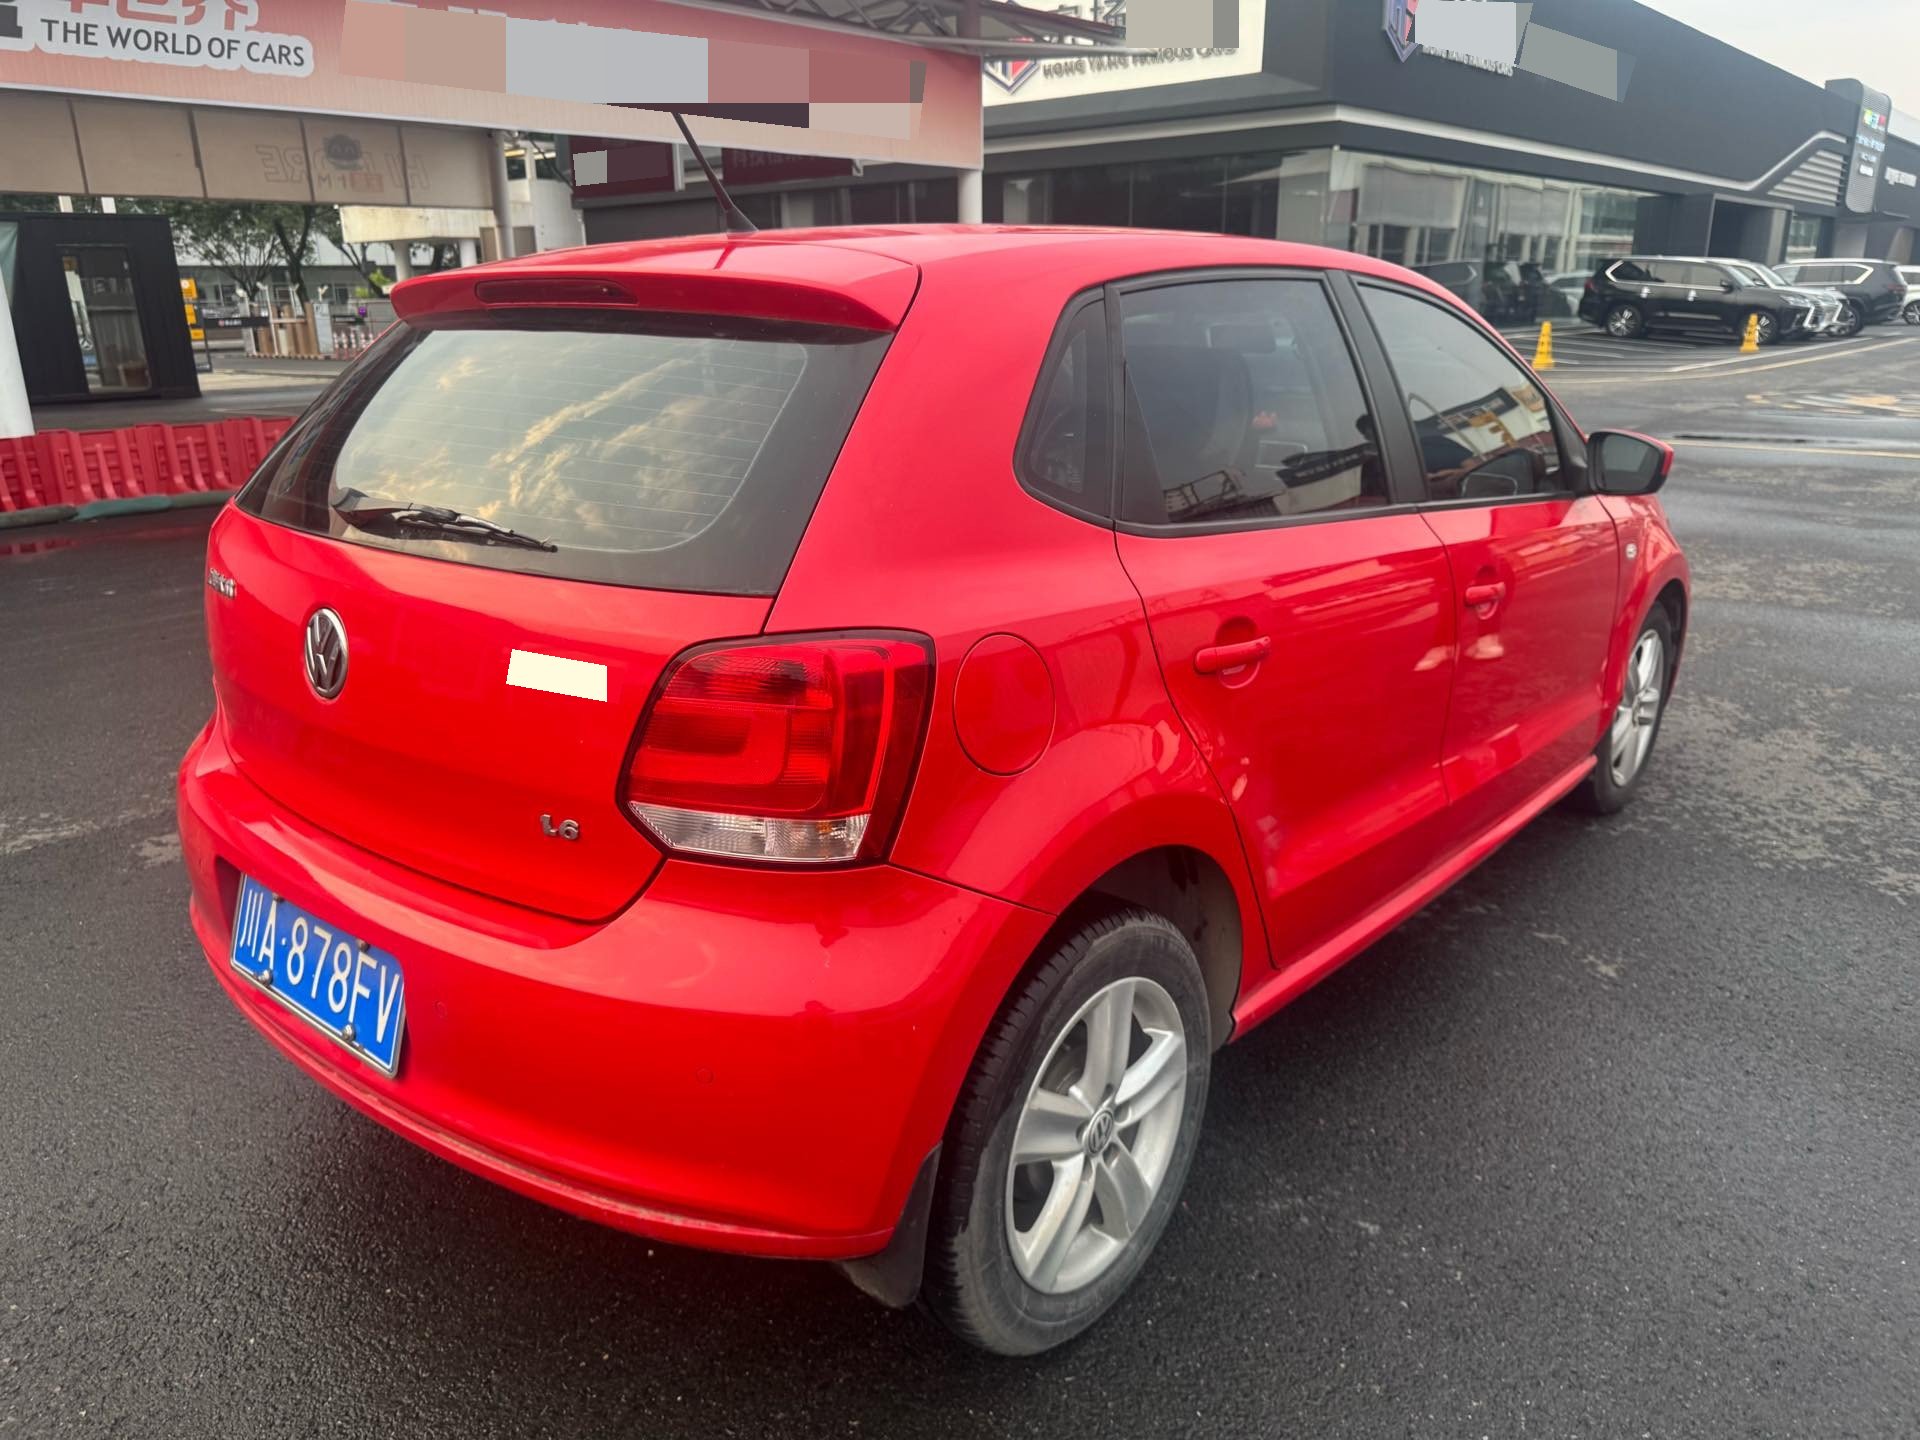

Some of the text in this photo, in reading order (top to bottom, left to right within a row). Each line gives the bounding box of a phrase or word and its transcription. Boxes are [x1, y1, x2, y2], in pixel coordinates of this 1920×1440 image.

[40, 18, 306, 67] THE WORLD OF CARS
[1042, 61, 1086, 80] HONG
